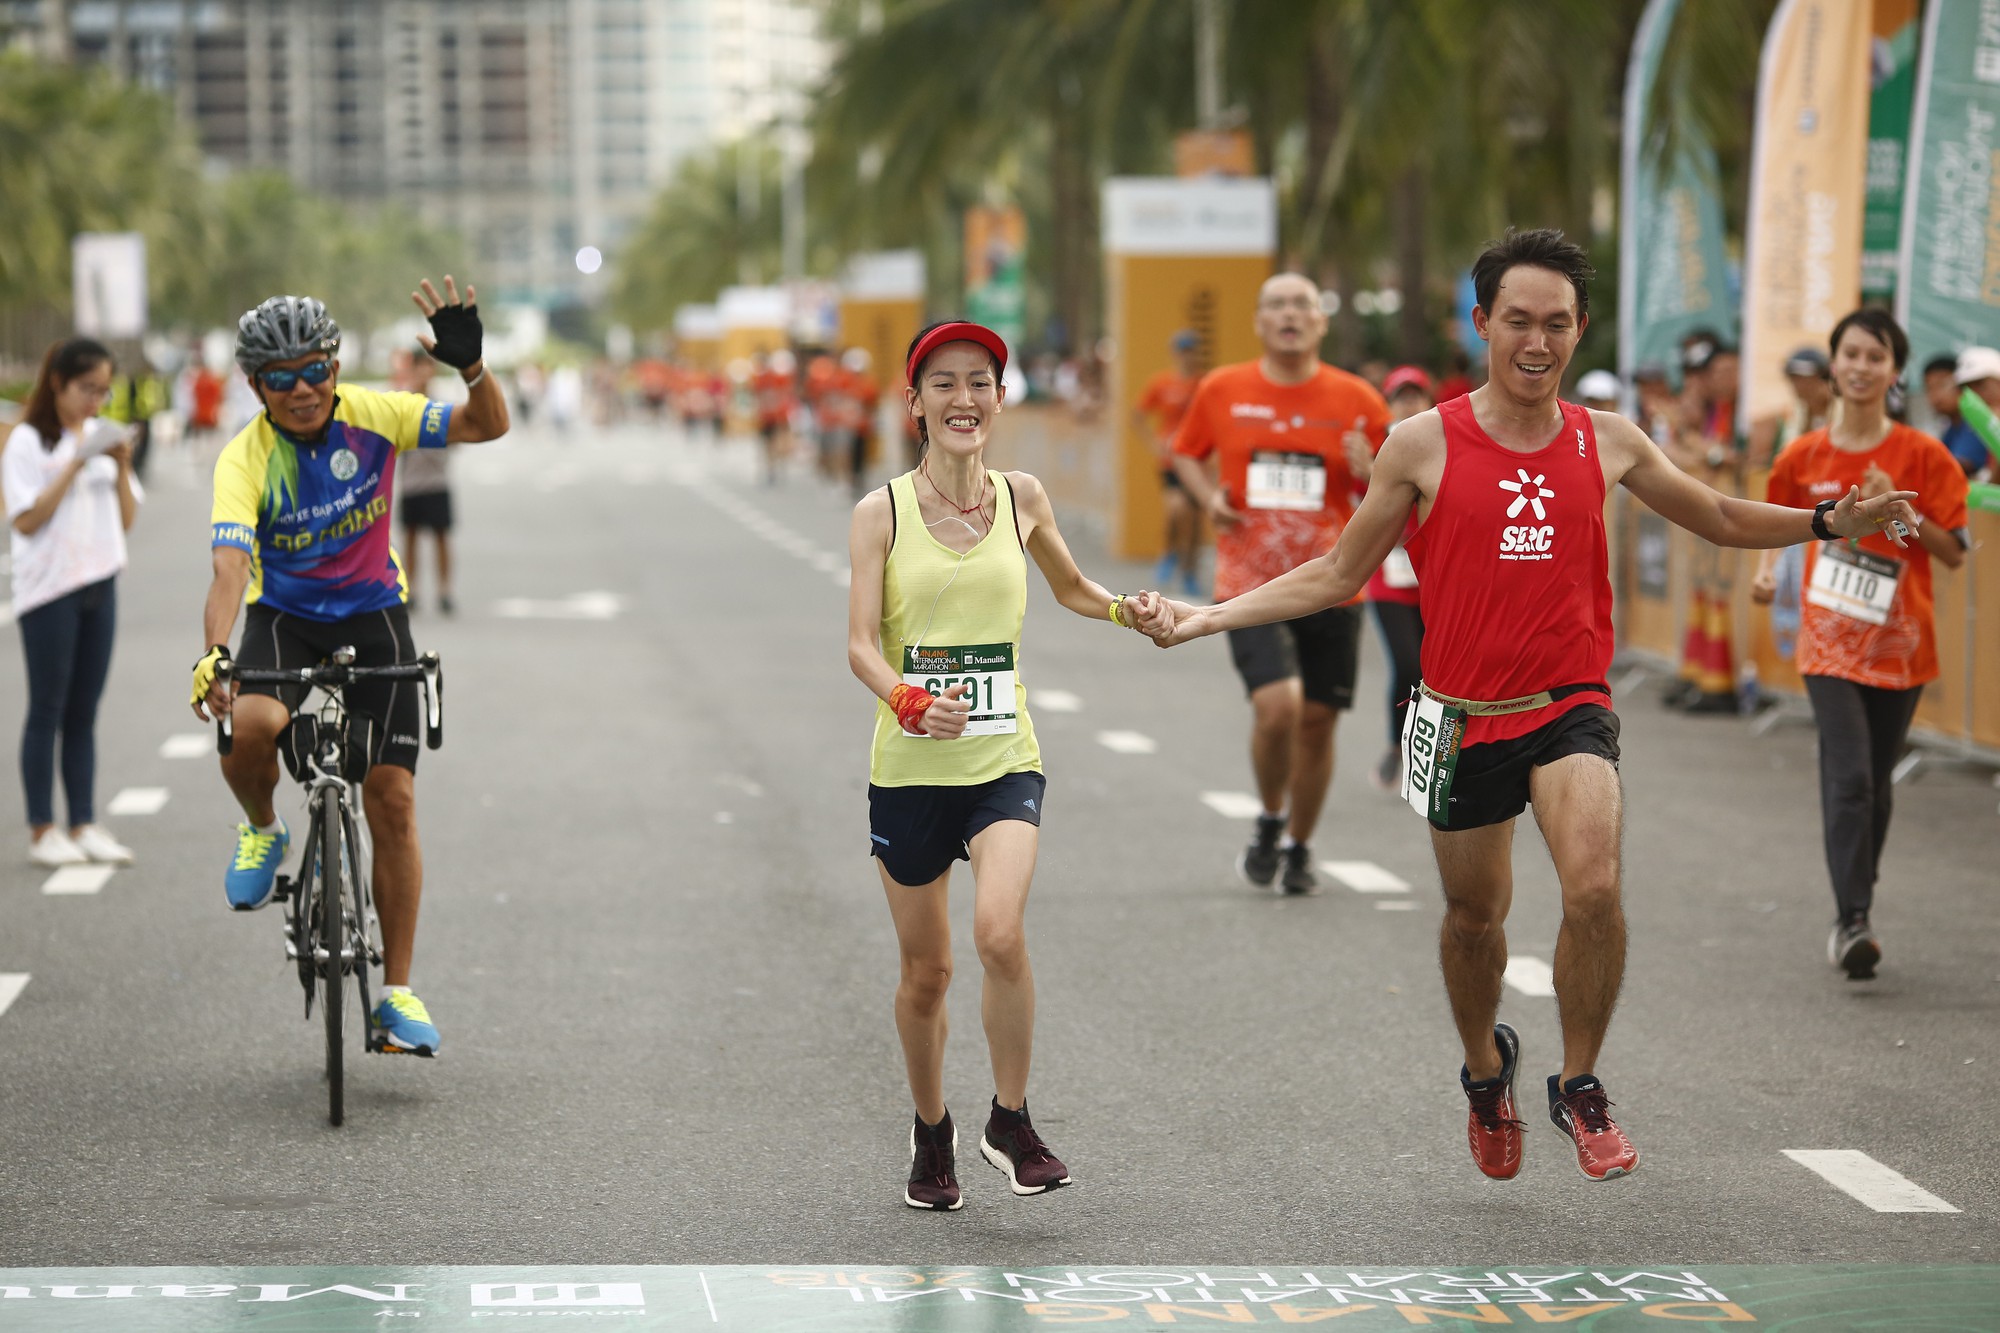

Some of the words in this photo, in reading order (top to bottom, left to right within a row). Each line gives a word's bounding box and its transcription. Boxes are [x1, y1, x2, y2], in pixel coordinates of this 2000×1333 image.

[1500, 525, 1555, 552] SRC
[1829, 564, 1878, 601] 1110
[913, 649, 949, 658] ANANG
[974, 655, 1006, 665] Manulife
[1412, 715, 1436, 794] 6670
[1434, 778, 1444, 813] Manulife
[765, 1271, 982, 1287] 2018
[1001, 1271, 1708, 1288] MARATHON
[799, 1286, 1732, 1304] INTERNATIONAL
[373, 1308, 421, 1318] by
[471, 1308, 646, 1319] powered
[1022, 1302, 1758, 1325] DANANG
